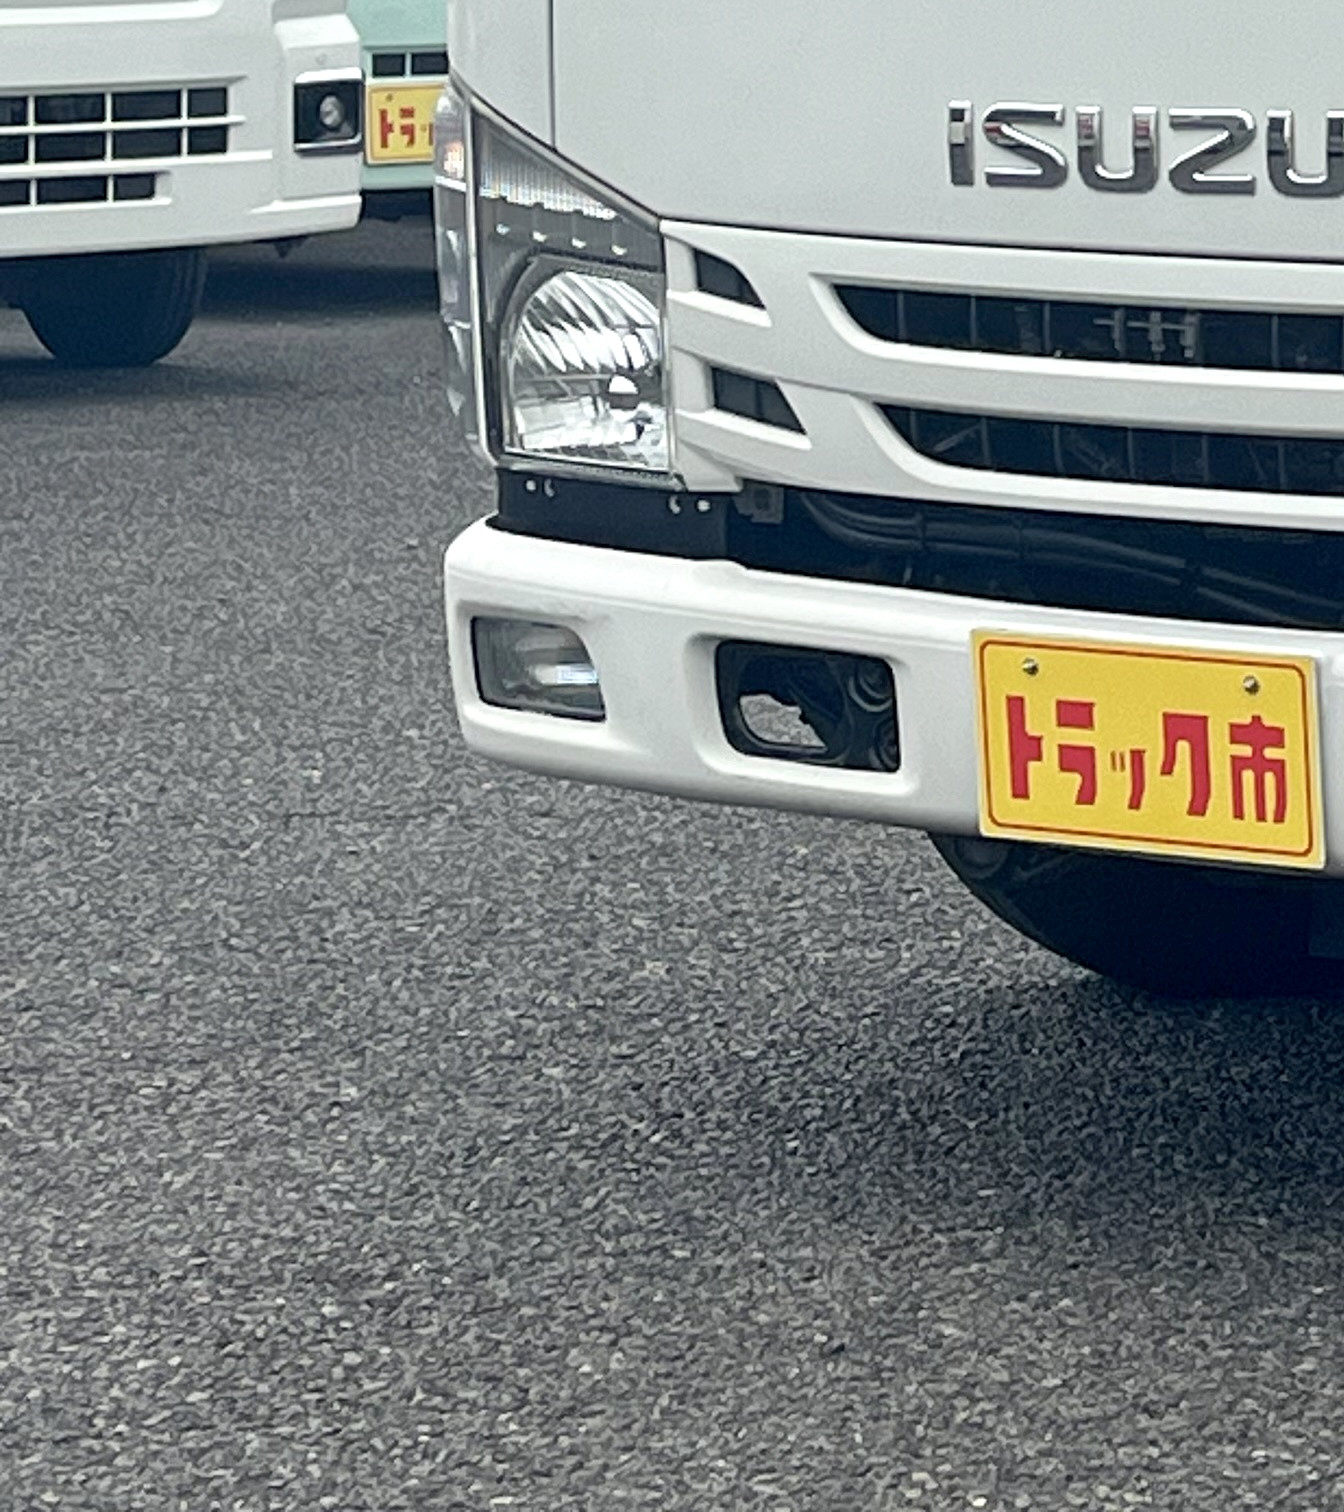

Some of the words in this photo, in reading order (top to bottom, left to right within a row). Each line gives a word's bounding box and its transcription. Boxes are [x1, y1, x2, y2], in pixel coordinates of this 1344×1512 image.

[1006, 694, 1289, 824] トラック市
